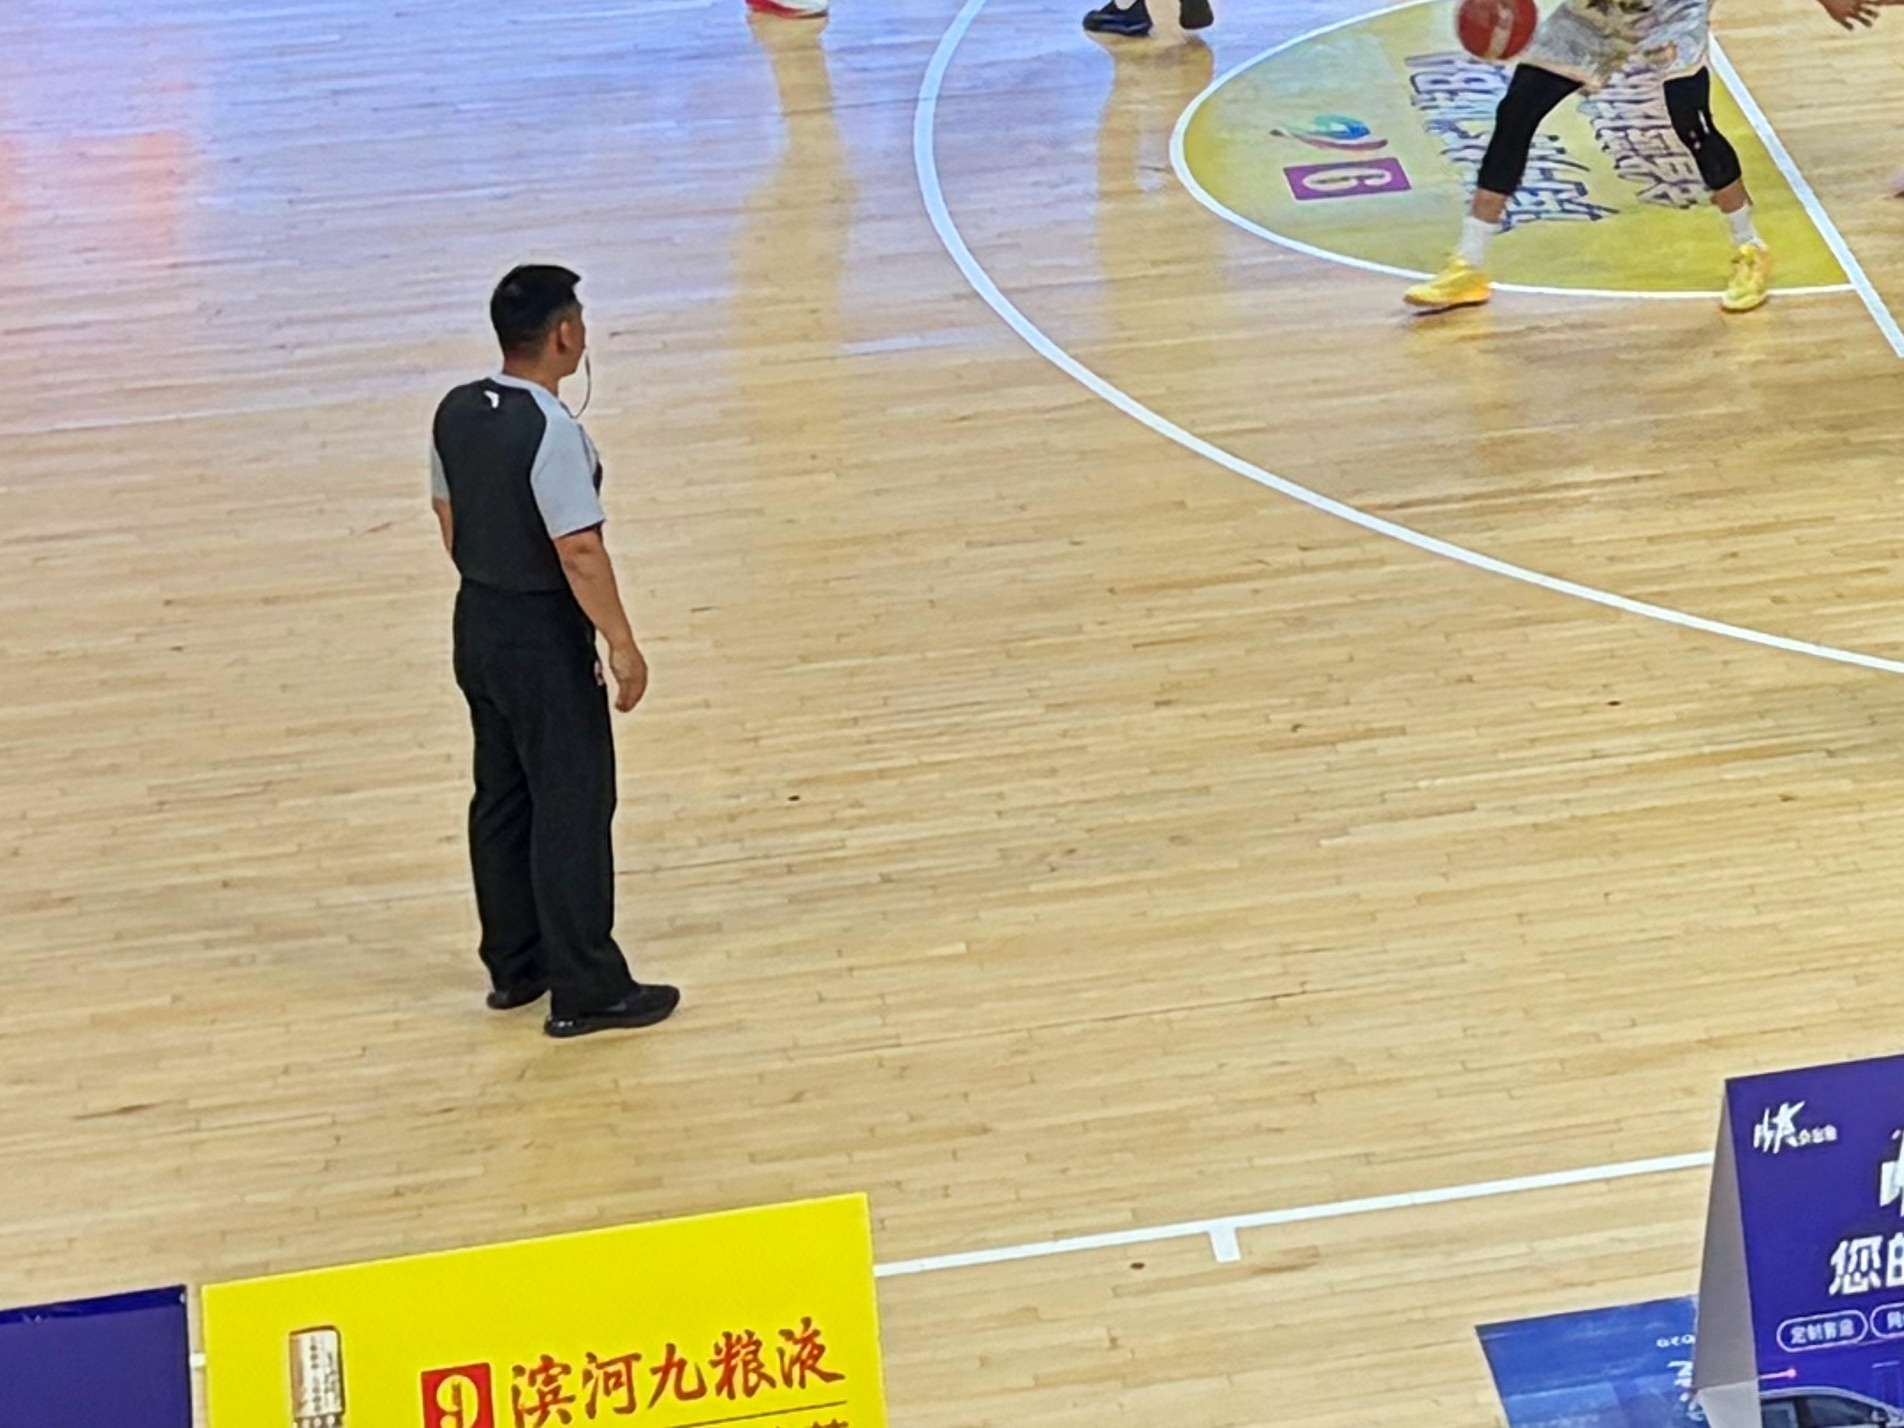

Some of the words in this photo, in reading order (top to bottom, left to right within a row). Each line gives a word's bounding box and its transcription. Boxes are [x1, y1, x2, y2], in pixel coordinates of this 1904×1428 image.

[508, 1316, 849, 1428] 滨河九粮液
